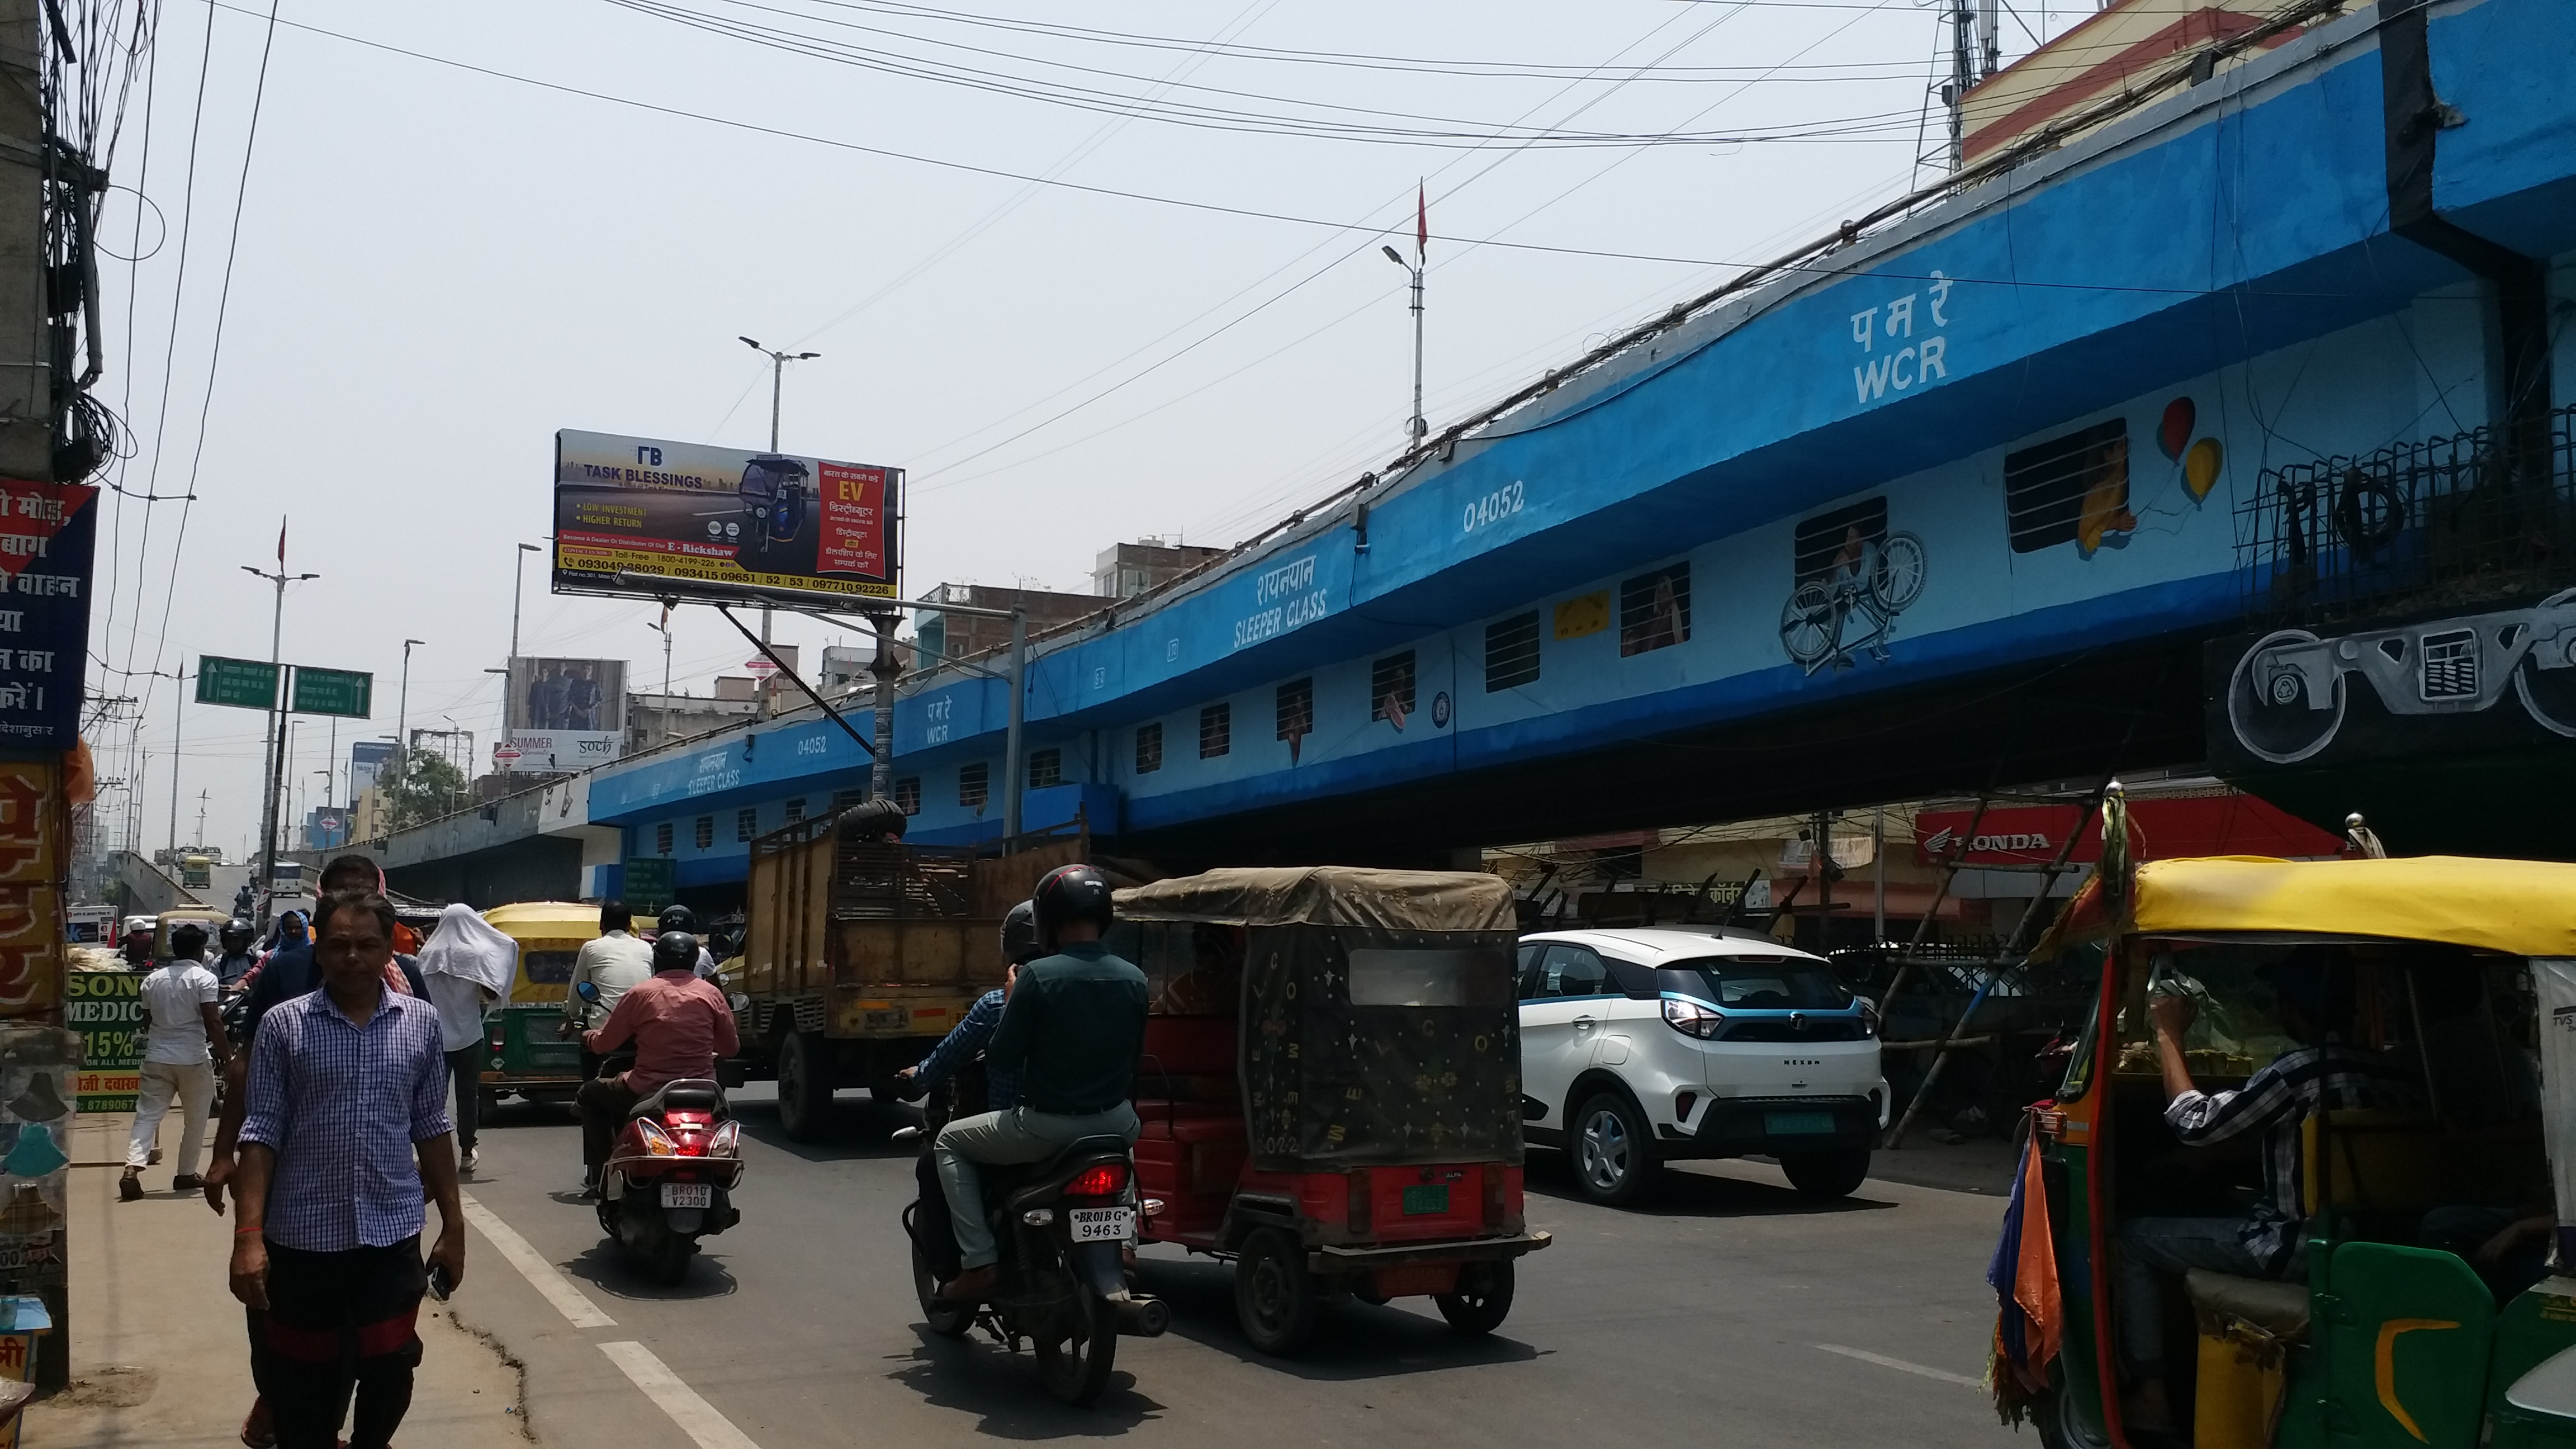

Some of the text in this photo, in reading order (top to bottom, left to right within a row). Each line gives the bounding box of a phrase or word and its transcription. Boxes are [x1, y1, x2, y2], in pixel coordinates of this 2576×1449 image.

[1854, 336, 1946, 404] WCR
[584, 464, 703, 489] TASK BLESSINGS
[840, 481, 864, 501] EV
[583, 503, 646, 517] LOW INVESTMENT
[1464, 480, 1524, 532] 04052
[583, 515, 642, 528] HIGHER RETURN
[683, 543, 733, 557] Rickshaw
[615, 551, 716, 568] Toll-Free 1800-4199-226
[766, 576, 780, 584] 52
[789, 577, 803, 586] 53
[1234, 588, 1327, 648] SLEEPER CLASS
[512, 737, 552, 749] SUMMER
[927, 725, 948, 744] WCR
[798, 736, 826, 755] 04052
[688, 769, 740, 795] SLEEPER CLASS
[2553, 1015, 2573, 1026] TVS
[84, 1031, 134, 1057] 15%
[673, 1196, 707, 1206] V2300
[1082, 1224, 1122, 1237] 9463
